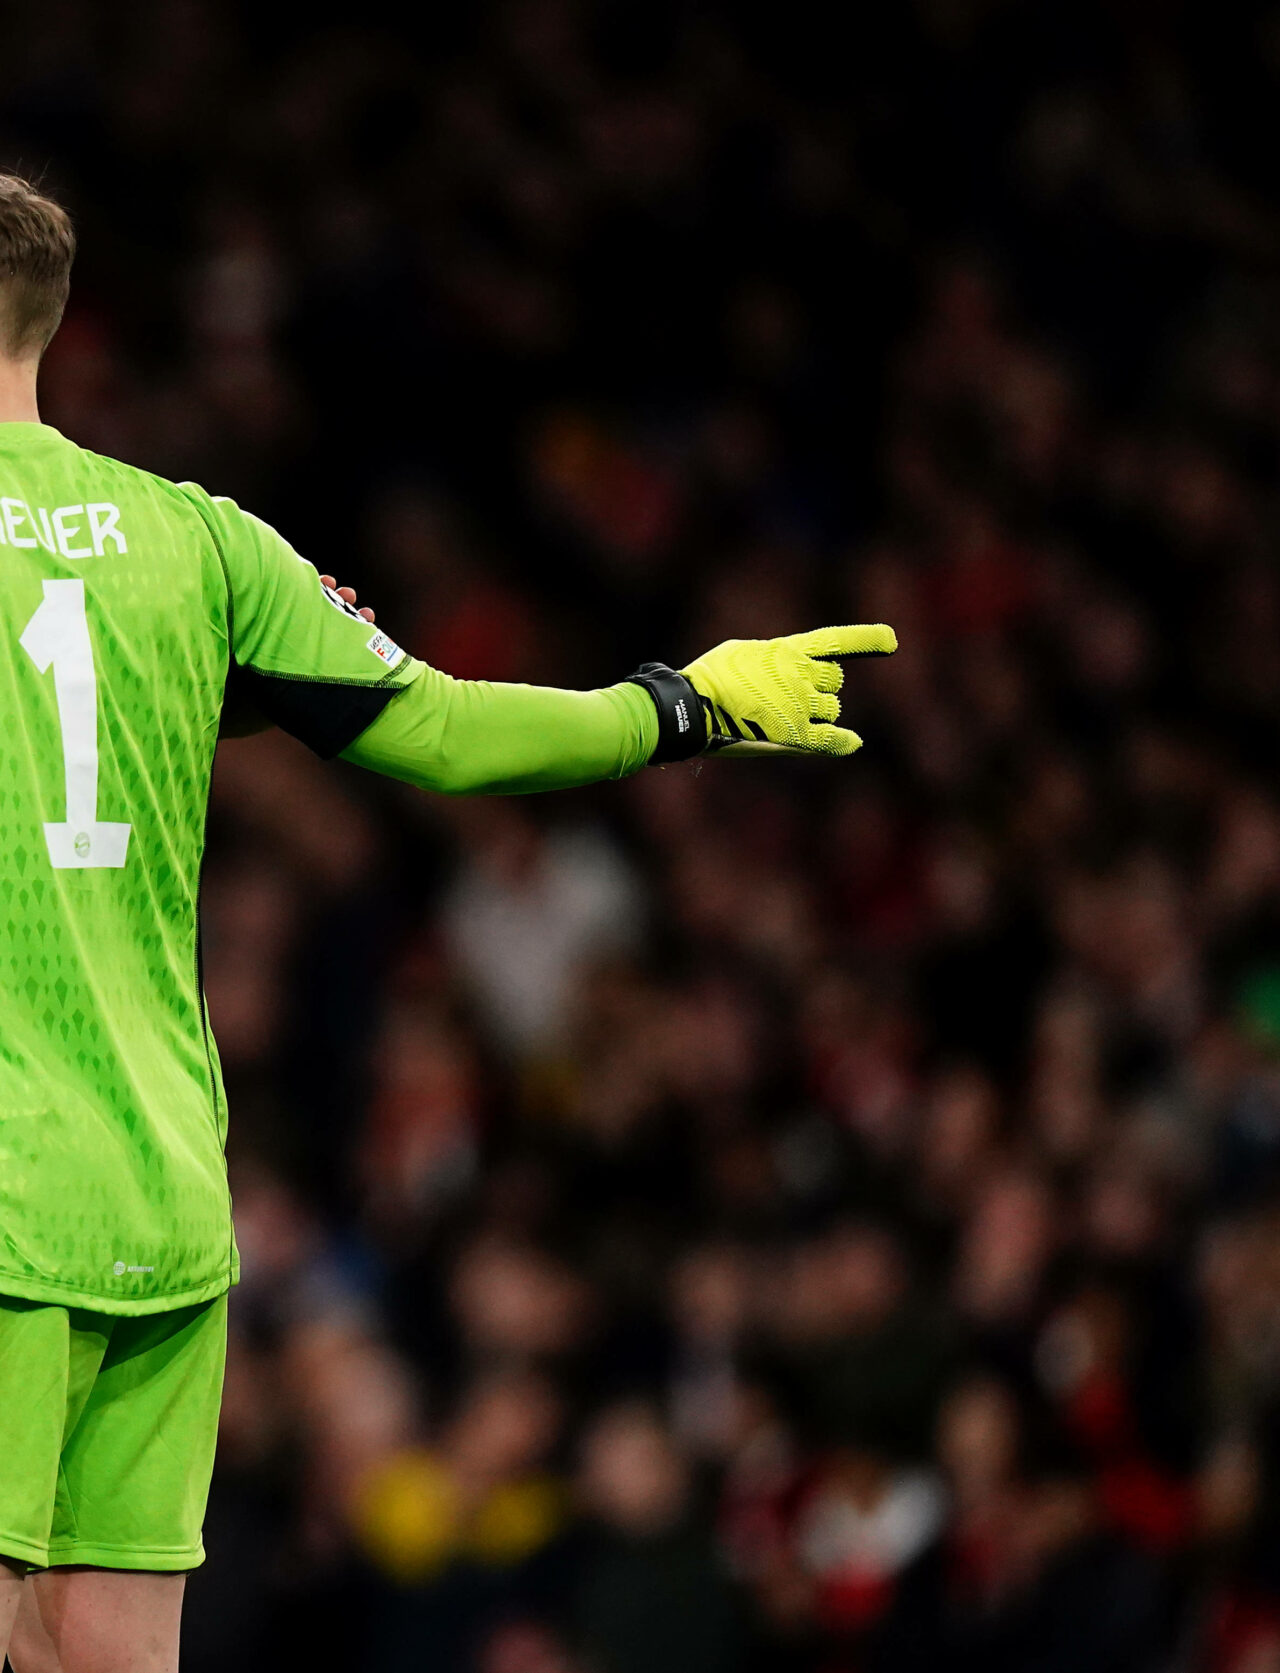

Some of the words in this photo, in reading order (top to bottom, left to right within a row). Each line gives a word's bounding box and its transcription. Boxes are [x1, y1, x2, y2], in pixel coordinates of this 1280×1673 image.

[19, 578, 132, 868] 1
[675, 705, 684, 733] NEUER
[679, 699, 690, 731] MANUEL
